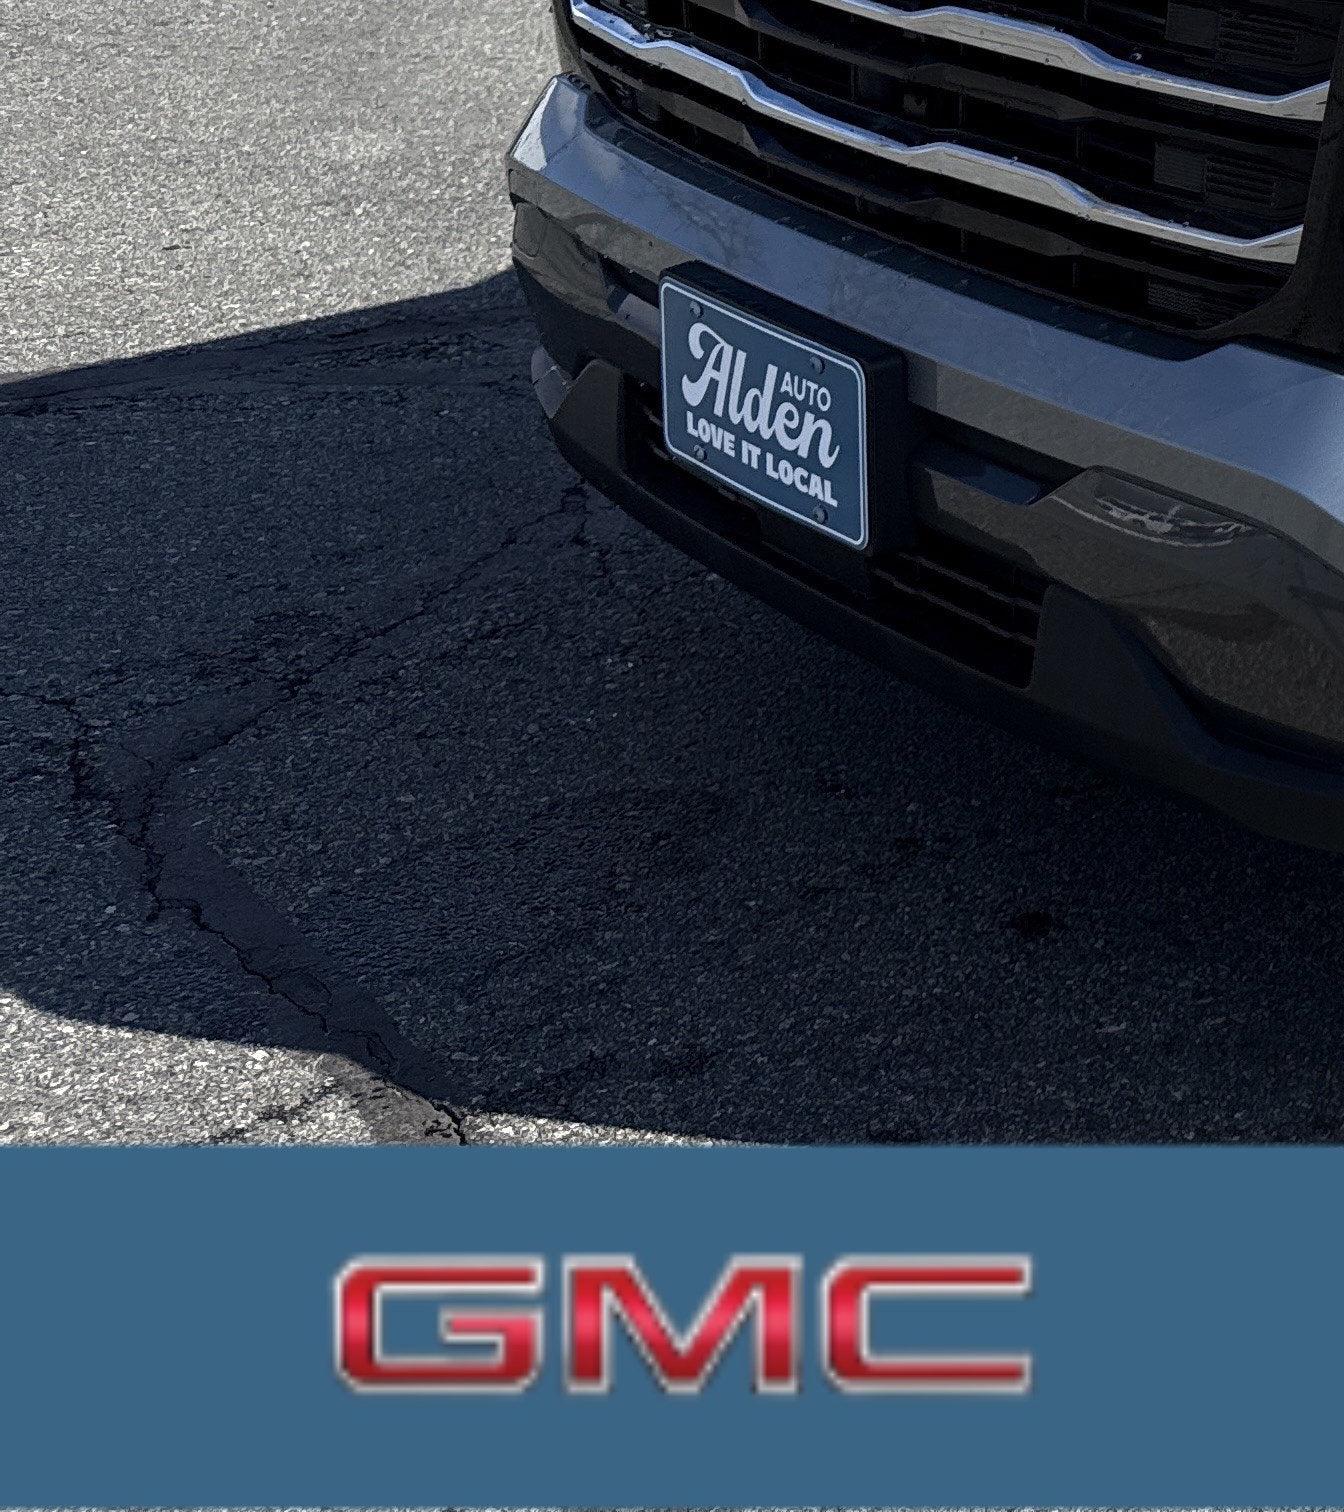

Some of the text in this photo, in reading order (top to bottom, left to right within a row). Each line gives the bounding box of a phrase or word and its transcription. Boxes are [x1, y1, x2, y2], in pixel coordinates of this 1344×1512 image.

[680, 321, 841, 469] Alden AUTO
[686, 410, 839, 509] LOVE IT LOCAL
